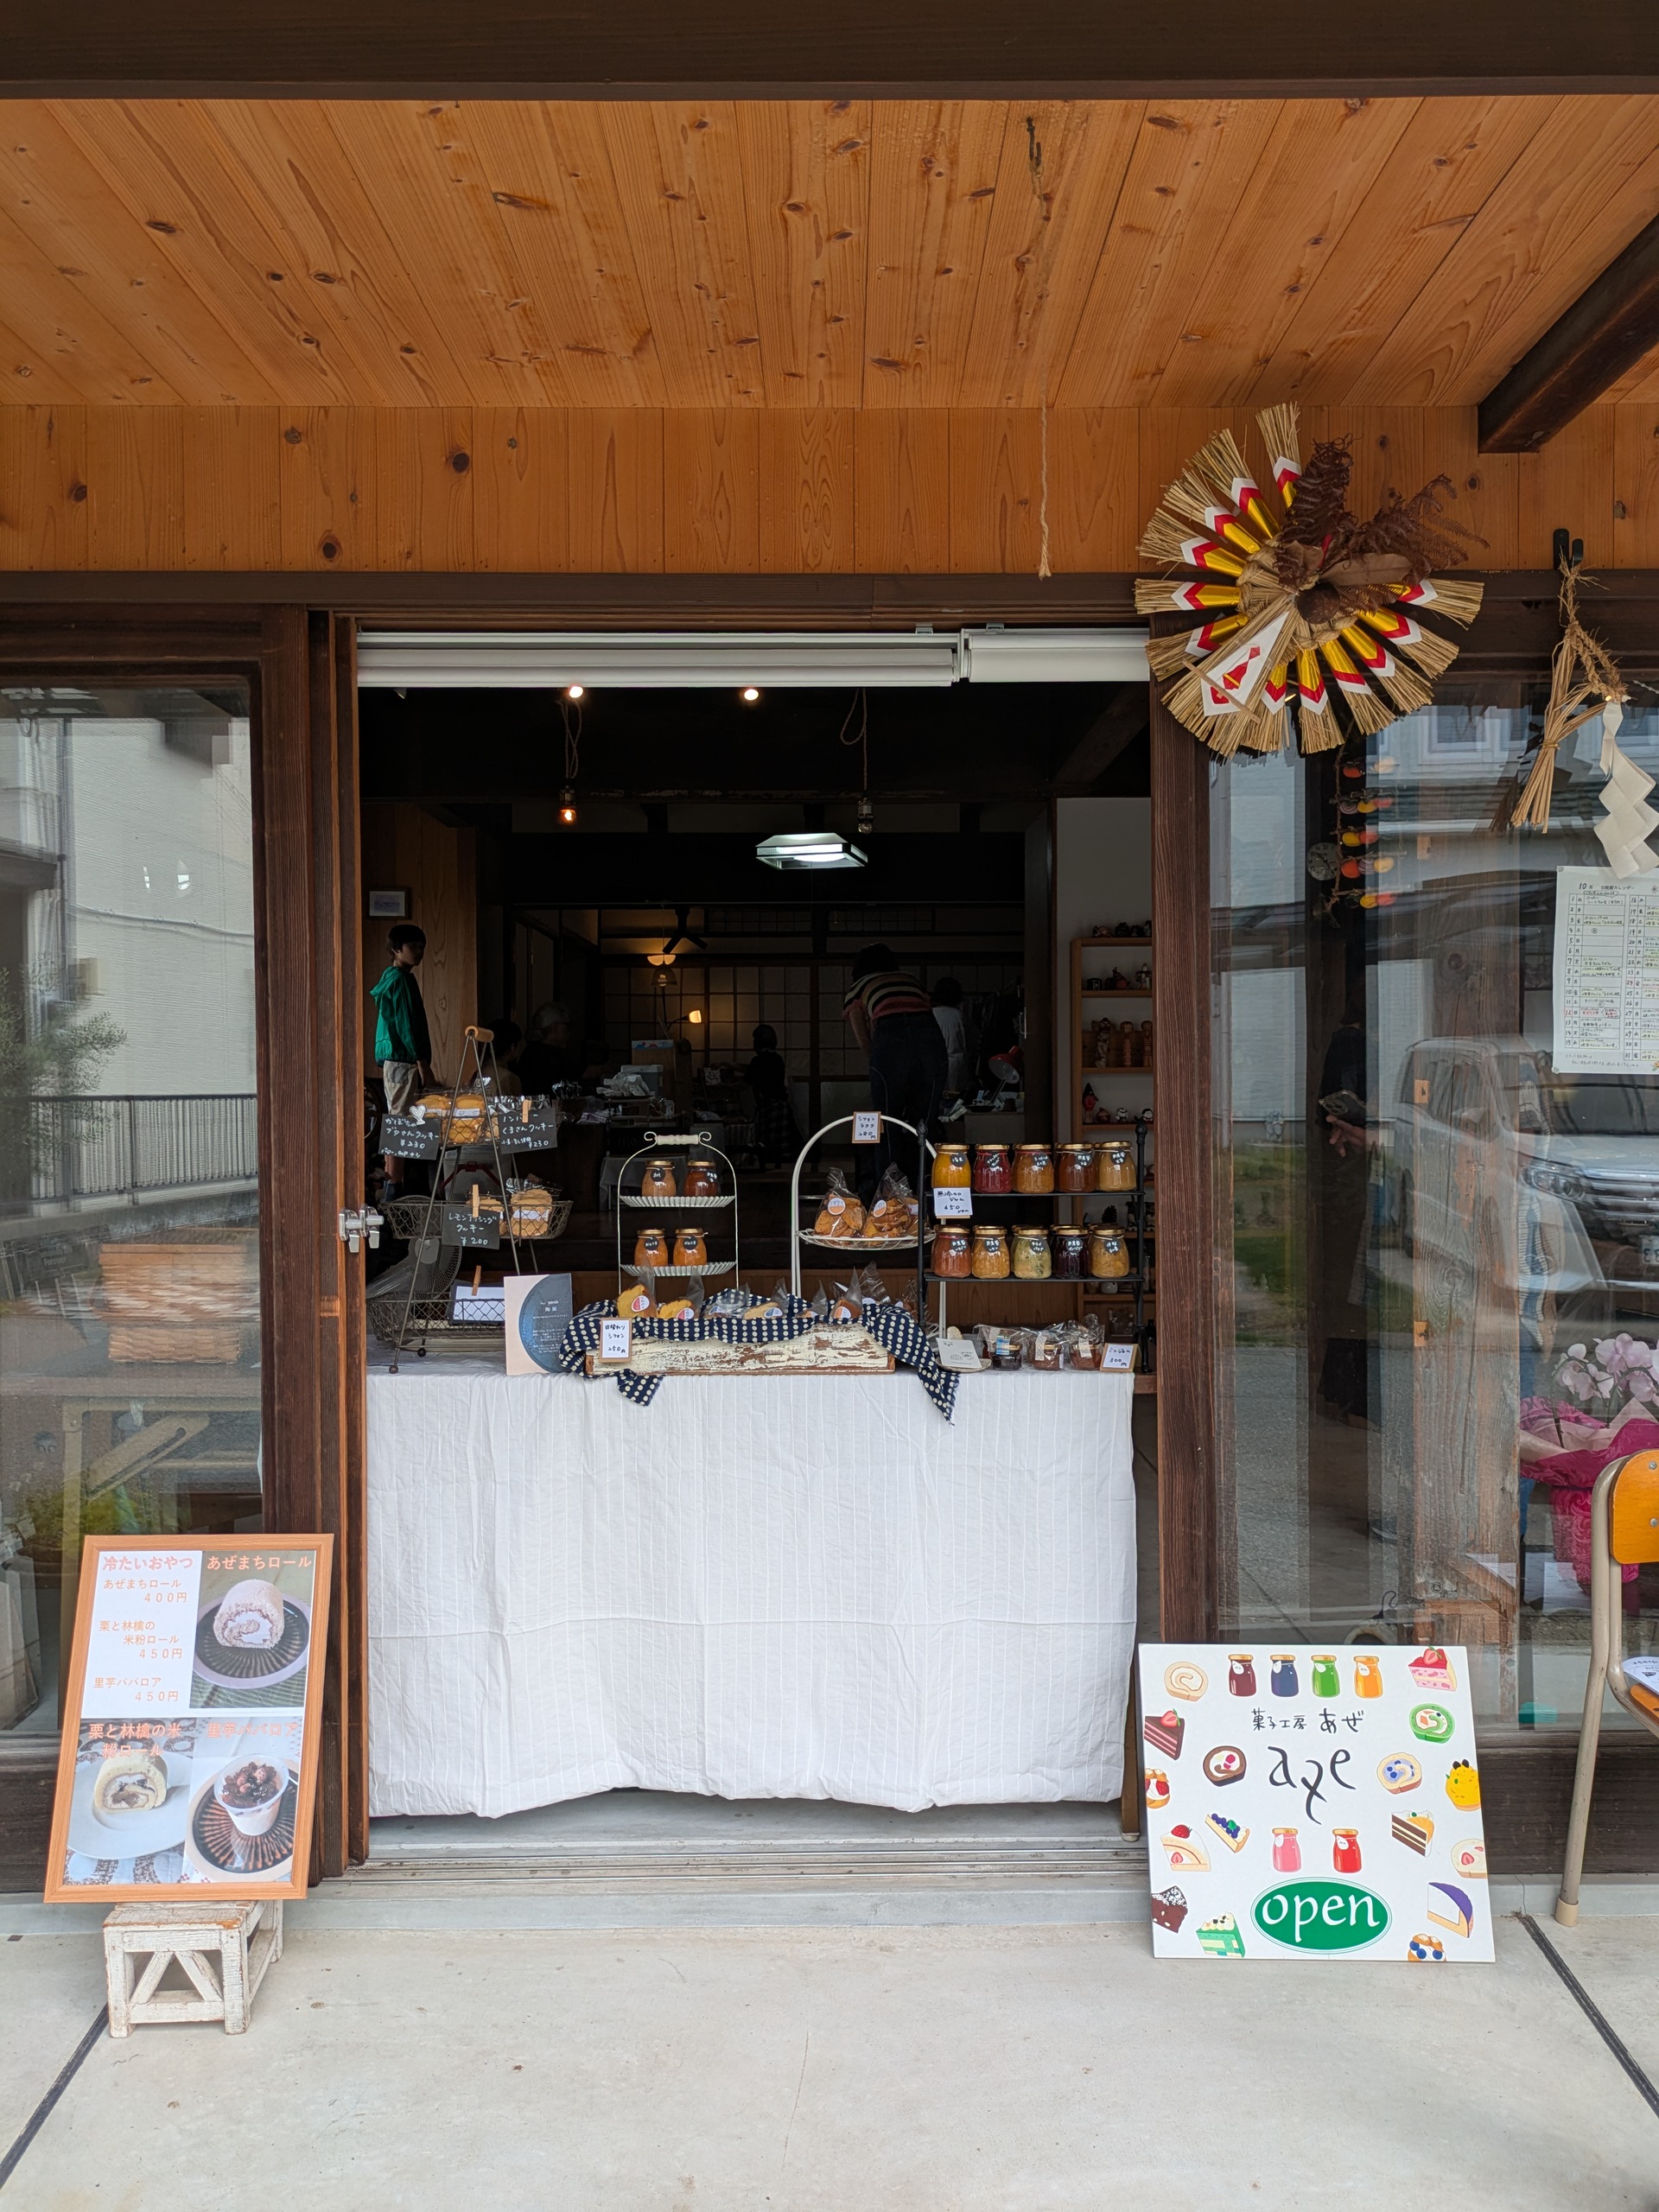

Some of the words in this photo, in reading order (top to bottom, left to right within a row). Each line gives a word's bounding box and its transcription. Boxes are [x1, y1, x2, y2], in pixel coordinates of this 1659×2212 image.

[457, 1224, 484, 1233] クッキー
[103, 1556, 194, 1571] 冷たいおやつ
[207, 1556, 312, 1570] あぜまちロール
[103, 1578, 182, 1590] あぜまちロール
[144, 1592, 187, 1603] 400円
[99, 1620, 156, 1632] 栗と林檎の
[123, 1635, 180, 1645] 米粉ロール
[139, 1648, 182, 1659] 450円
[93, 1677, 162, 1689] 里芋ババロア
[135, 1691, 179, 1702] 450円
[1251, 1707, 1307, 1731] 菓子工房
[1320, 1709, 1364, 1733] あぜ
[89, 1723, 181, 1738] 栗と林檎の米
[207, 1722, 298, 1738] 里芋ババロア
[102, 1743, 164, 1759] 粉ロール
[1262, 1893, 1380, 1943] open
